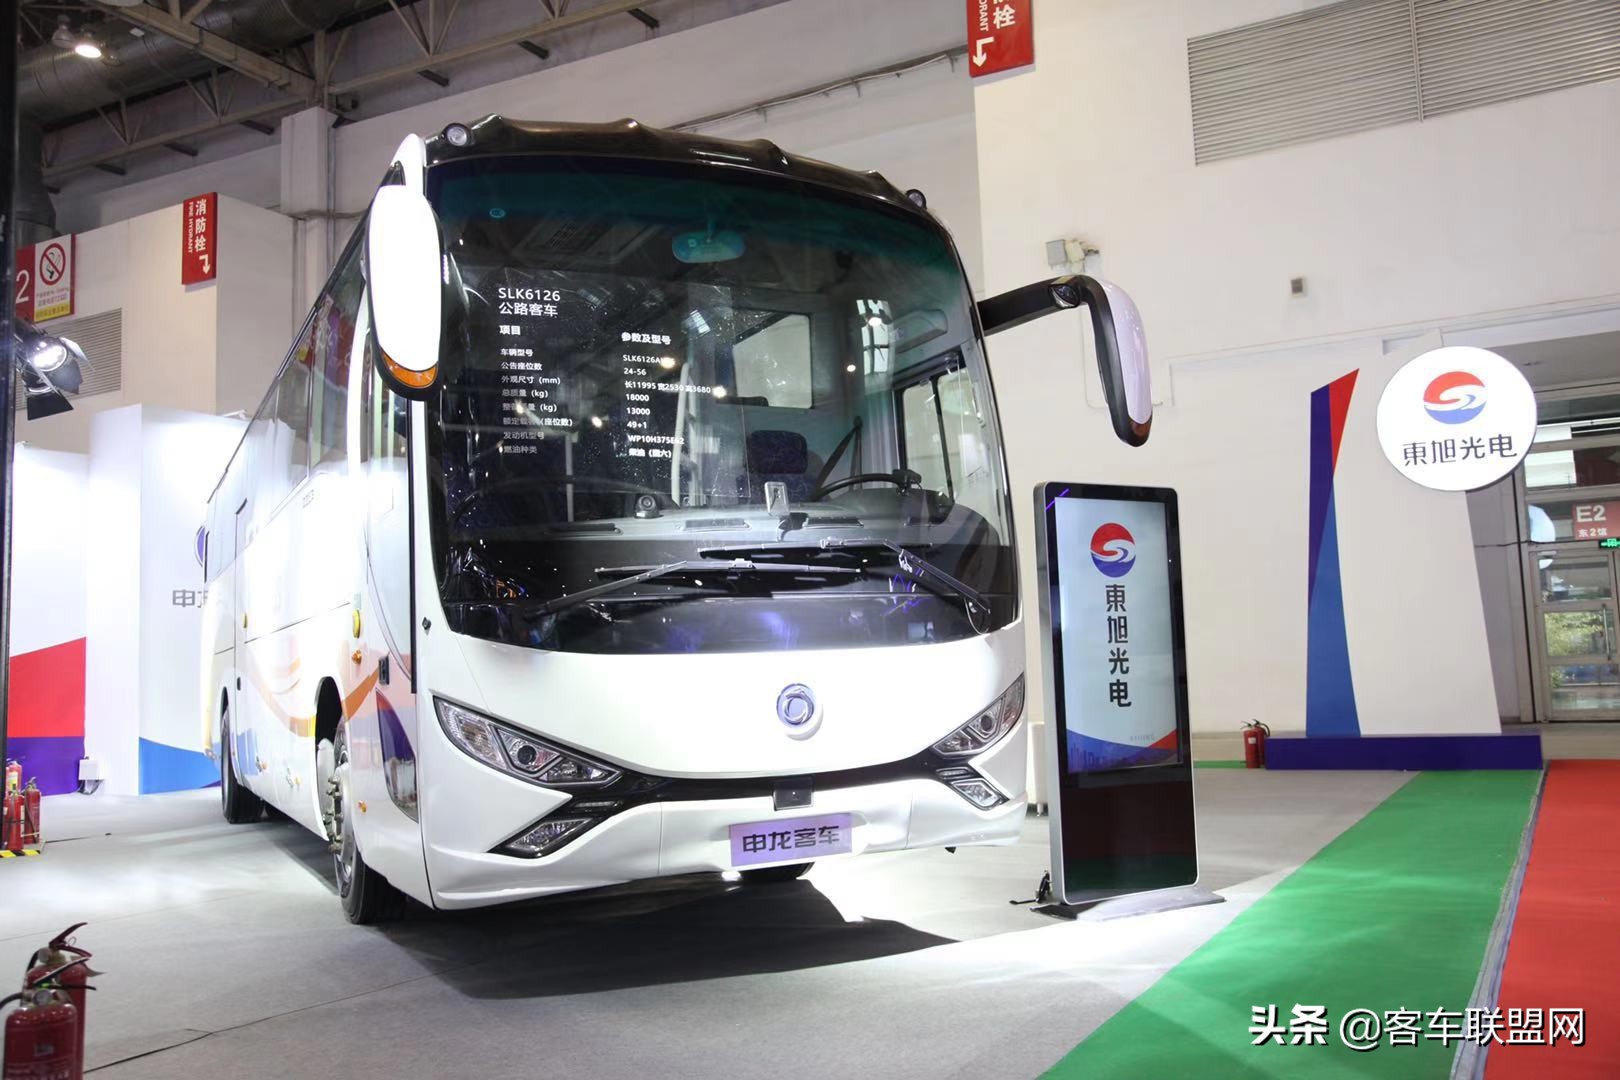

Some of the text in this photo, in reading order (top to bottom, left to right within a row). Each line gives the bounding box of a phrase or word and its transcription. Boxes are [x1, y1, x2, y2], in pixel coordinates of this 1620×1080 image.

[993, 0, 1016, 30] 栓
[194, 198, 207, 253] 消防栓
[498, 287, 561, 302] SLK6126
[498, 302, 558, 317] 公路客车
[498, 325, 521, 336] 项目
[621, 331, 672, 345] 参数及型号
[500, 348, 534, 357] 车辆型号
[500, 362, 543, 371] 公告座位数
[623, 367, 647, 376] 24-56
[625, 393, 650, 402] 18000
[626, 407, 651, 416] 13000
[626, 421, 648, 429] 49+1
[1402, 434, 1518, 467] 東旭光电
[1576, 504, 1607, 522] E2
[1105, 584, 1132, 707] 東旭光电
[742, 825, 840, 853] 申龙客车
